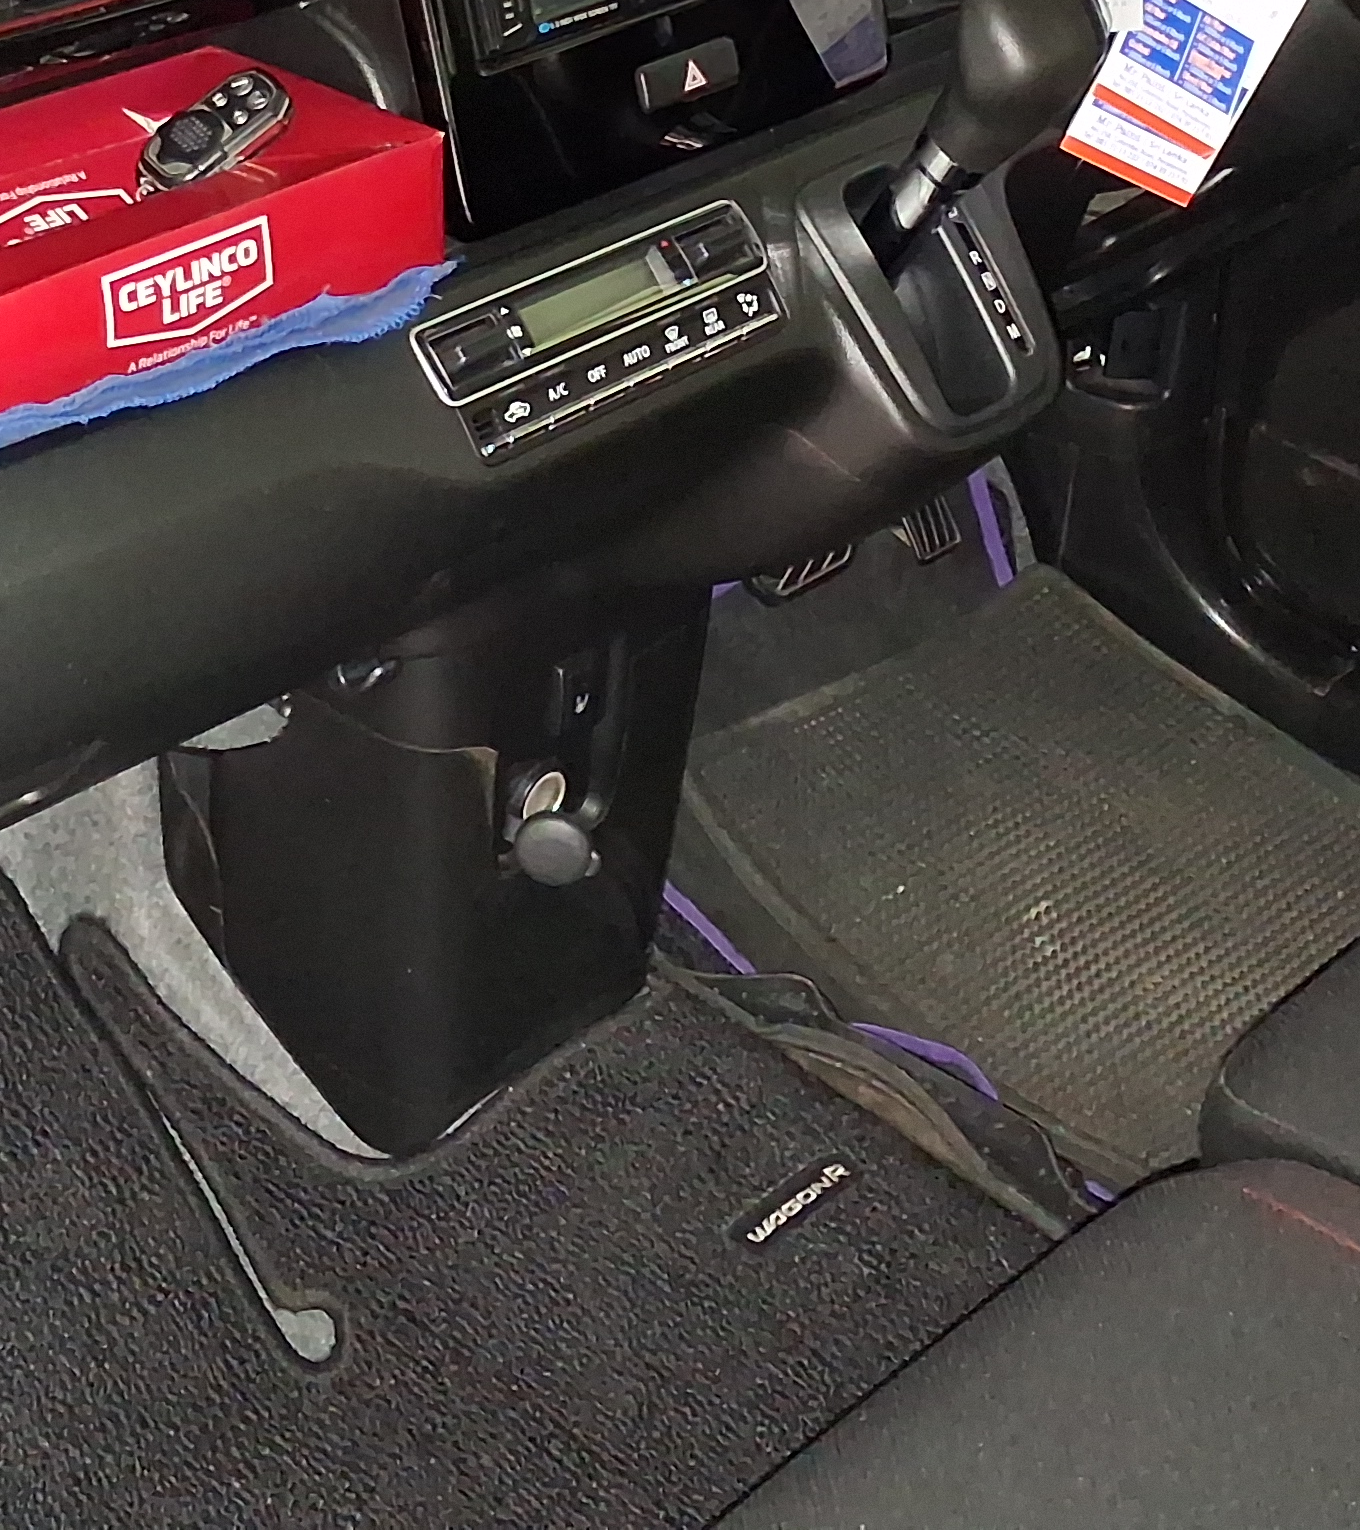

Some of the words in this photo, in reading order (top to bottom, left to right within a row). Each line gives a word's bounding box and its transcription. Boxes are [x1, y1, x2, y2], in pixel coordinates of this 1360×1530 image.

[968, 250, 983, 266] R
[118, 238, 258, 313] CEYLINCO
[161, 279, 225, 326] LIFE
[993, 299, 1006, 314] D
[1006, 322, 1022, 340] M
[138, 334, 209, 369] Relationship
[623, 345, 651, 368] AUTO
[587, 364, 607, 383] OFF
[548, 381, 569, 402] A/C
